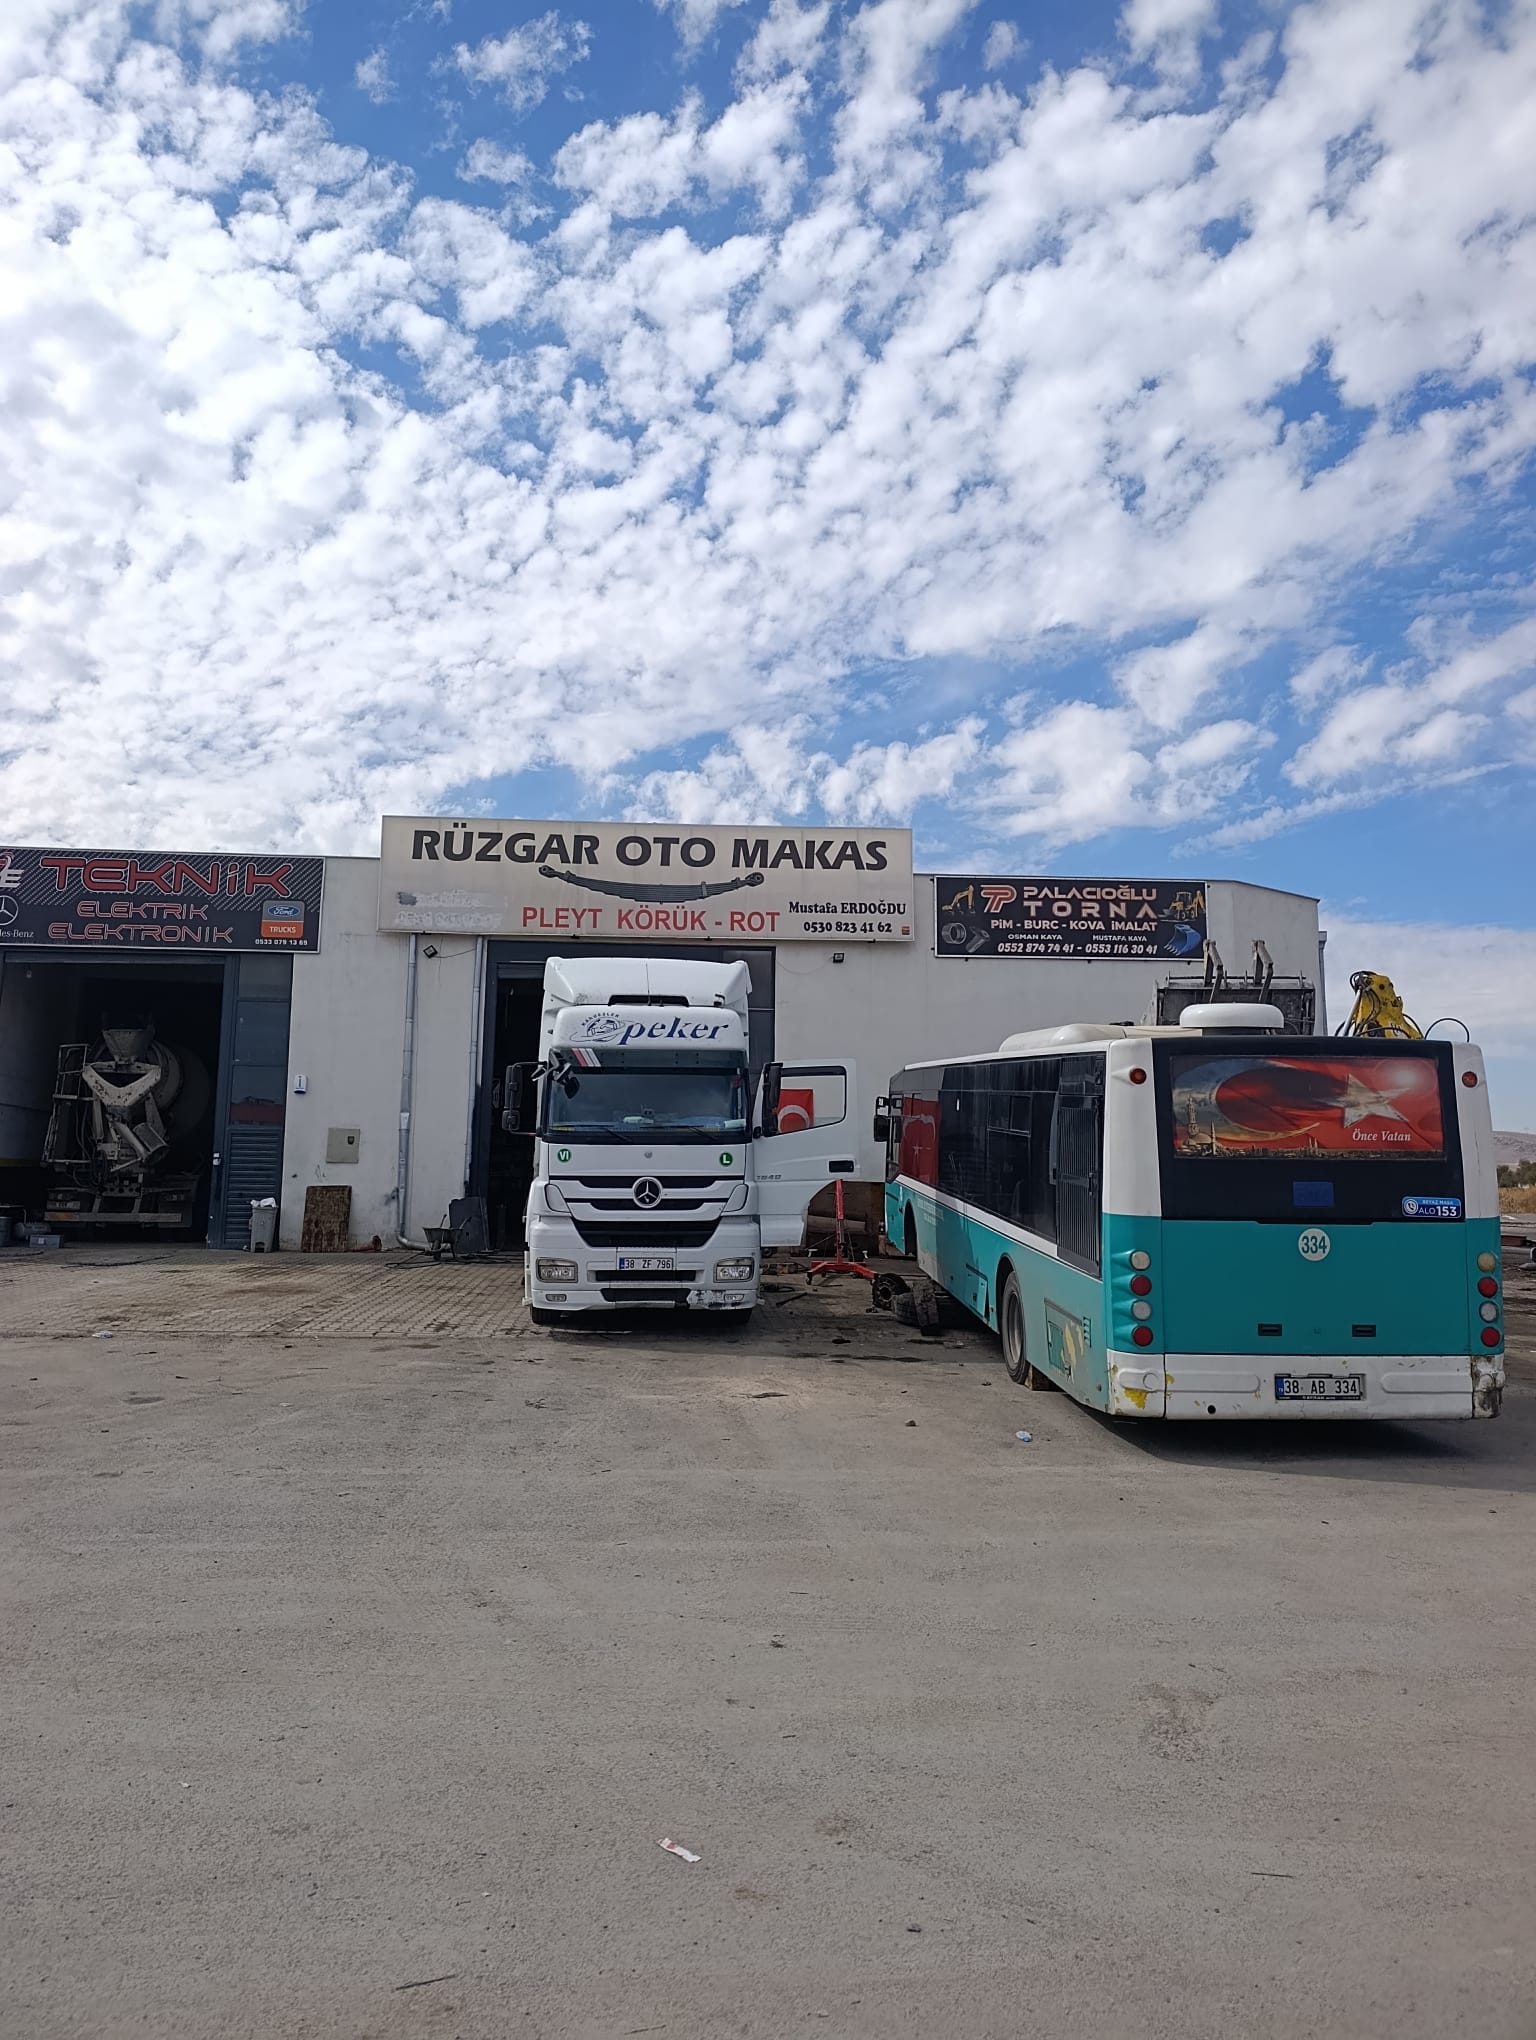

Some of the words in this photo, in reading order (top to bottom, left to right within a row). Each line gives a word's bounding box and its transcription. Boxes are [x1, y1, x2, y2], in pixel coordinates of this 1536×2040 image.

[412, 822, 599, 865] RÜZGAR
[616, 835, 716, 868] OTO
[731, 838, 888, 871] MAKAS
[788, 901, 838, 914] Mustafa
[840, 899, 906, 915] ERDOĞDU
[1023, 901, 1158, 919] TORNA
[522, 906, 603, 929] PLEYT
[617, 905, 707, 931] KÖRÜK
[730, 911, 780, 932] ROT
[1069, 920, 1105, 930] KOVA
[269, 926, 297, 934] TRUCKS
[803, 921, 832, 934] 0530
[835, 921, 857, 934] 823
[860, 922, 874, 933] 41
[877, 921, 892, 933] 62
[1092, 934, 1127, 942] MUSTAFA
[997, 942, 1023, 953] 0552
[1025, 943, 1045, 953] 874
[1047, 943, 1060, 953] 74
[1062, 943, 1074, 953] 41
[1085, 943, 1111, 954] 0553
[1113, 944, 1128, 954] 116
[1130, 944, 1144, 954] 30
[1145, 944, 1158, 955] 41
[616, 1016, 730, 1046] peker
[1352, 1128, 1378, 1141] Önce
[1381, 1130, 1411, 1142] Vatan
[722, 1154, 731, 1165] L
[1418, 1207, 1436, 1215] ALO
[1436, 1205, 1457, 1217] 153
[1301, 1235, 1327, 1254] 334
[625, 1259, 635, 1269] 38
[642, 1259, 652, 1269] ZF
[656, 1259, 671, 1269] 796
[1284, 1380, 1300, 1394] 38
[1310, 1380, 1326, 1394] AB
[1335, 1380, 1357, 1394] 334
